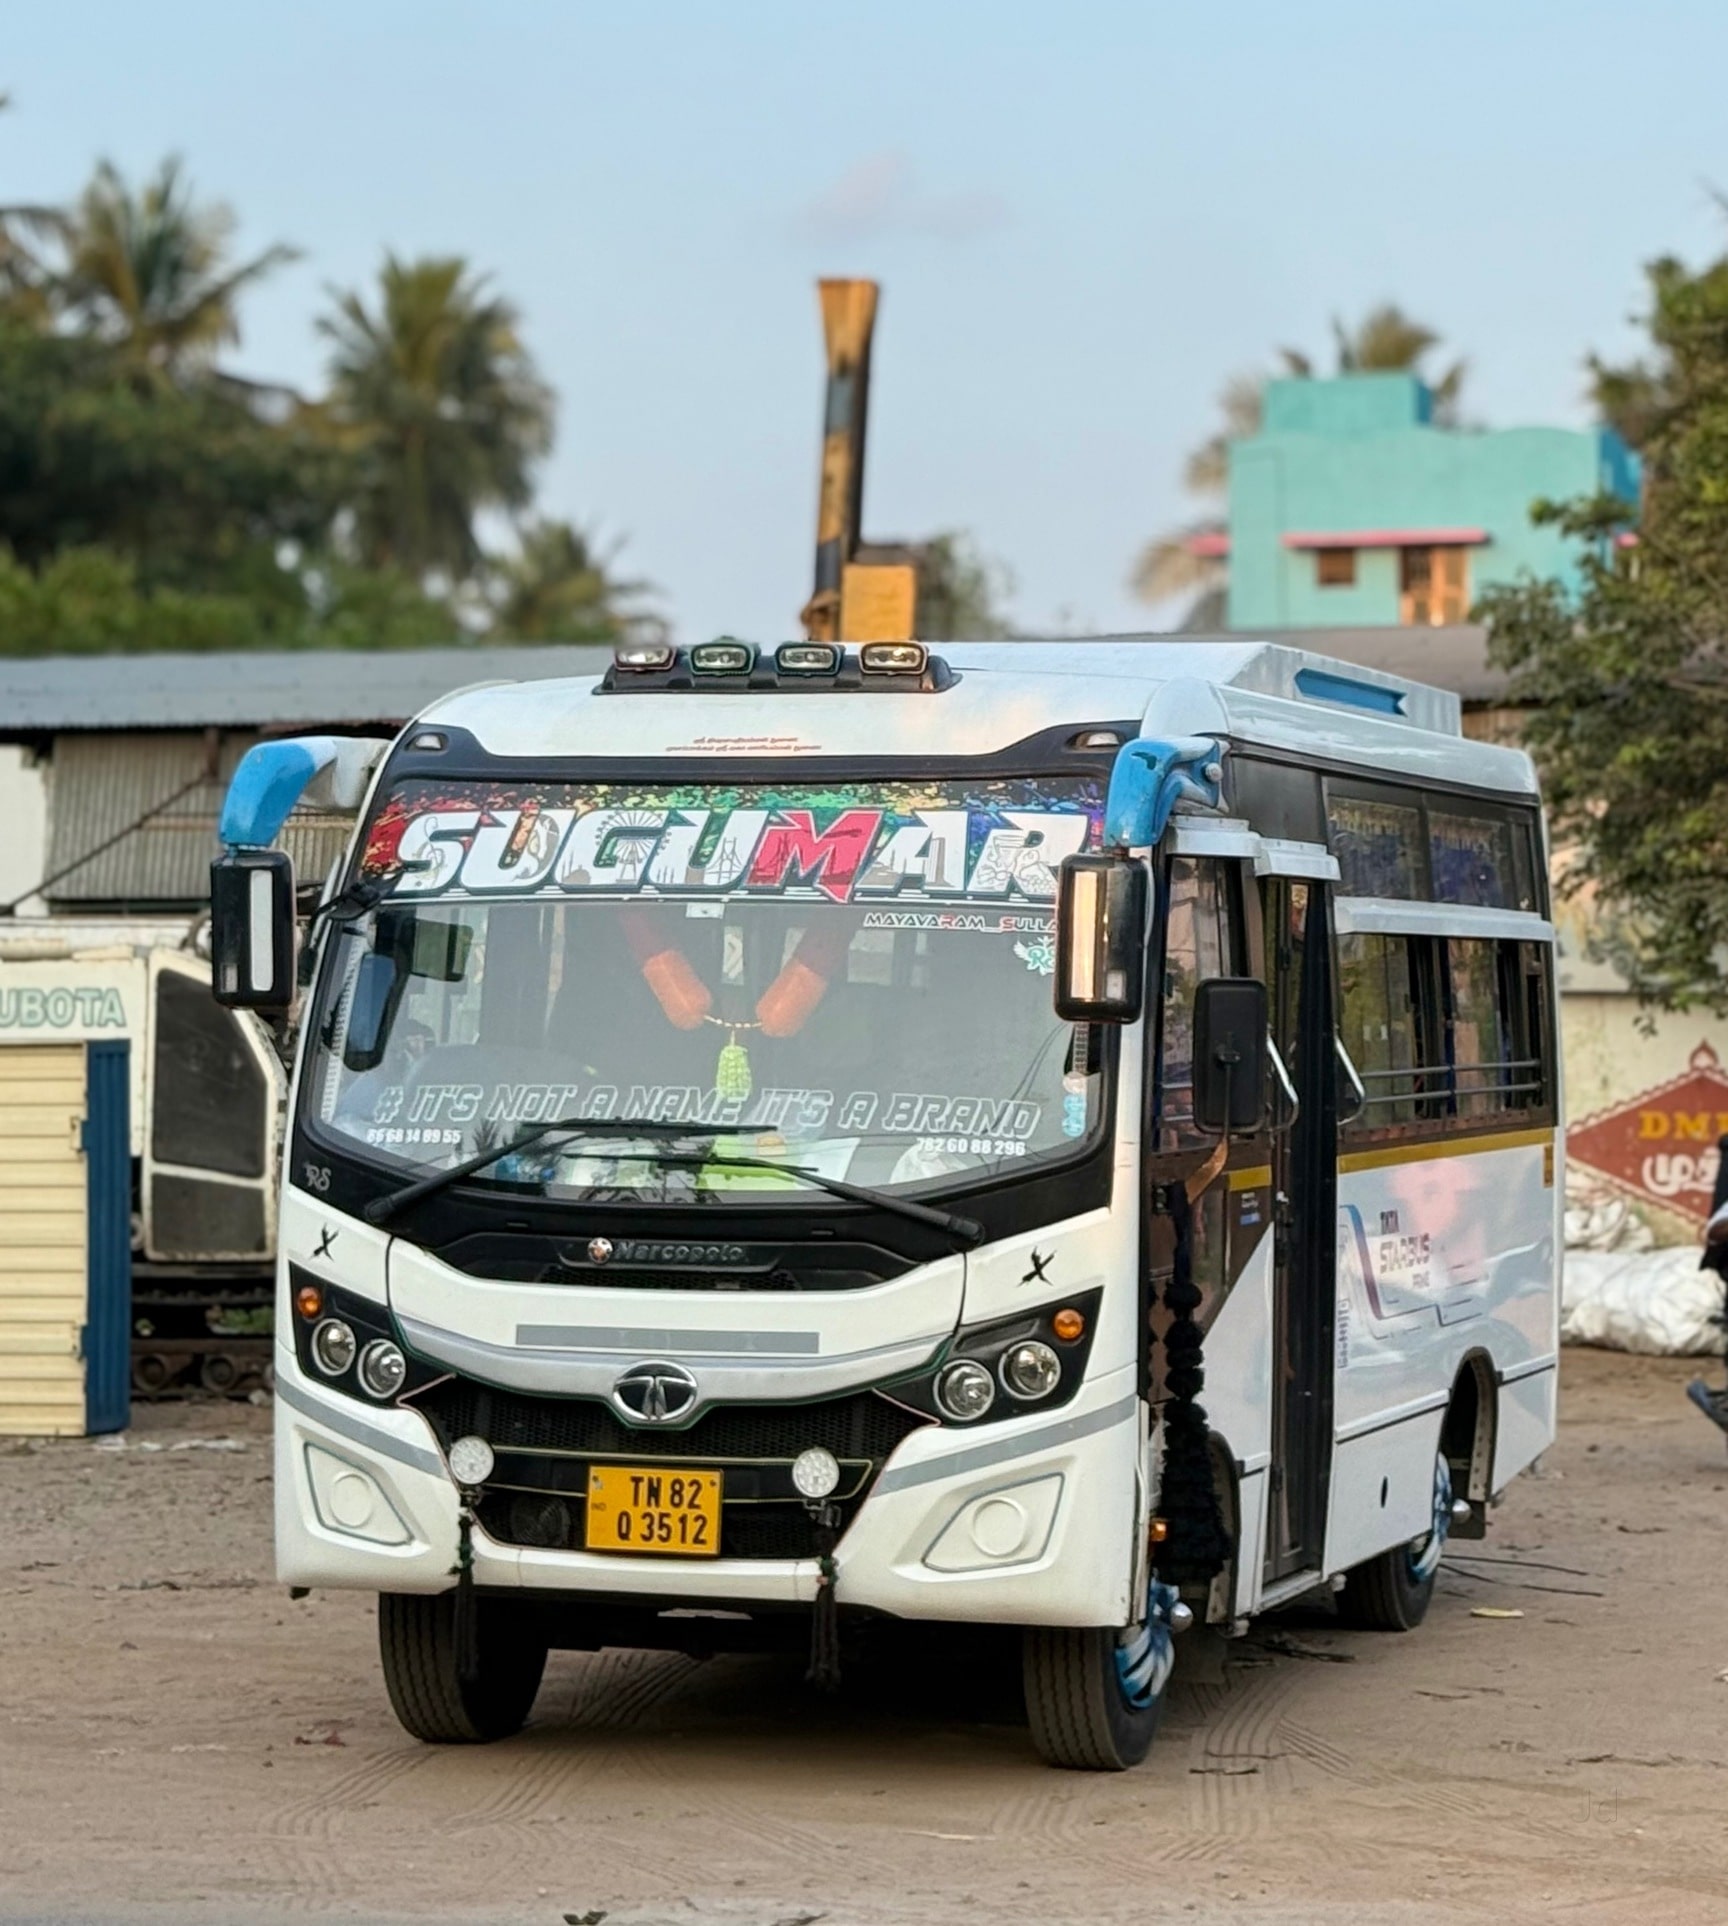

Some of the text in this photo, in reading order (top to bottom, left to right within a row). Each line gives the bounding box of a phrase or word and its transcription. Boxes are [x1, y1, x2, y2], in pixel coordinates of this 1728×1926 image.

[393, 808, 1089, 903] SUGUMAR
[407, 1084, 484, 1123] IT'S
[488, 1084, 578, 1122] NOT
[580, 1085, 618, 1121] A
[624, 1085, 749, 1126] NAME
[751, 1088, 834, 1128] IT'S
[838, 1091, 877, 1130] A
[882, 1092, 1042, 1139] BRAND
[630, 1476, 703, 1510] TN 82
[617, 1510, 708, 1545] Q 3512
